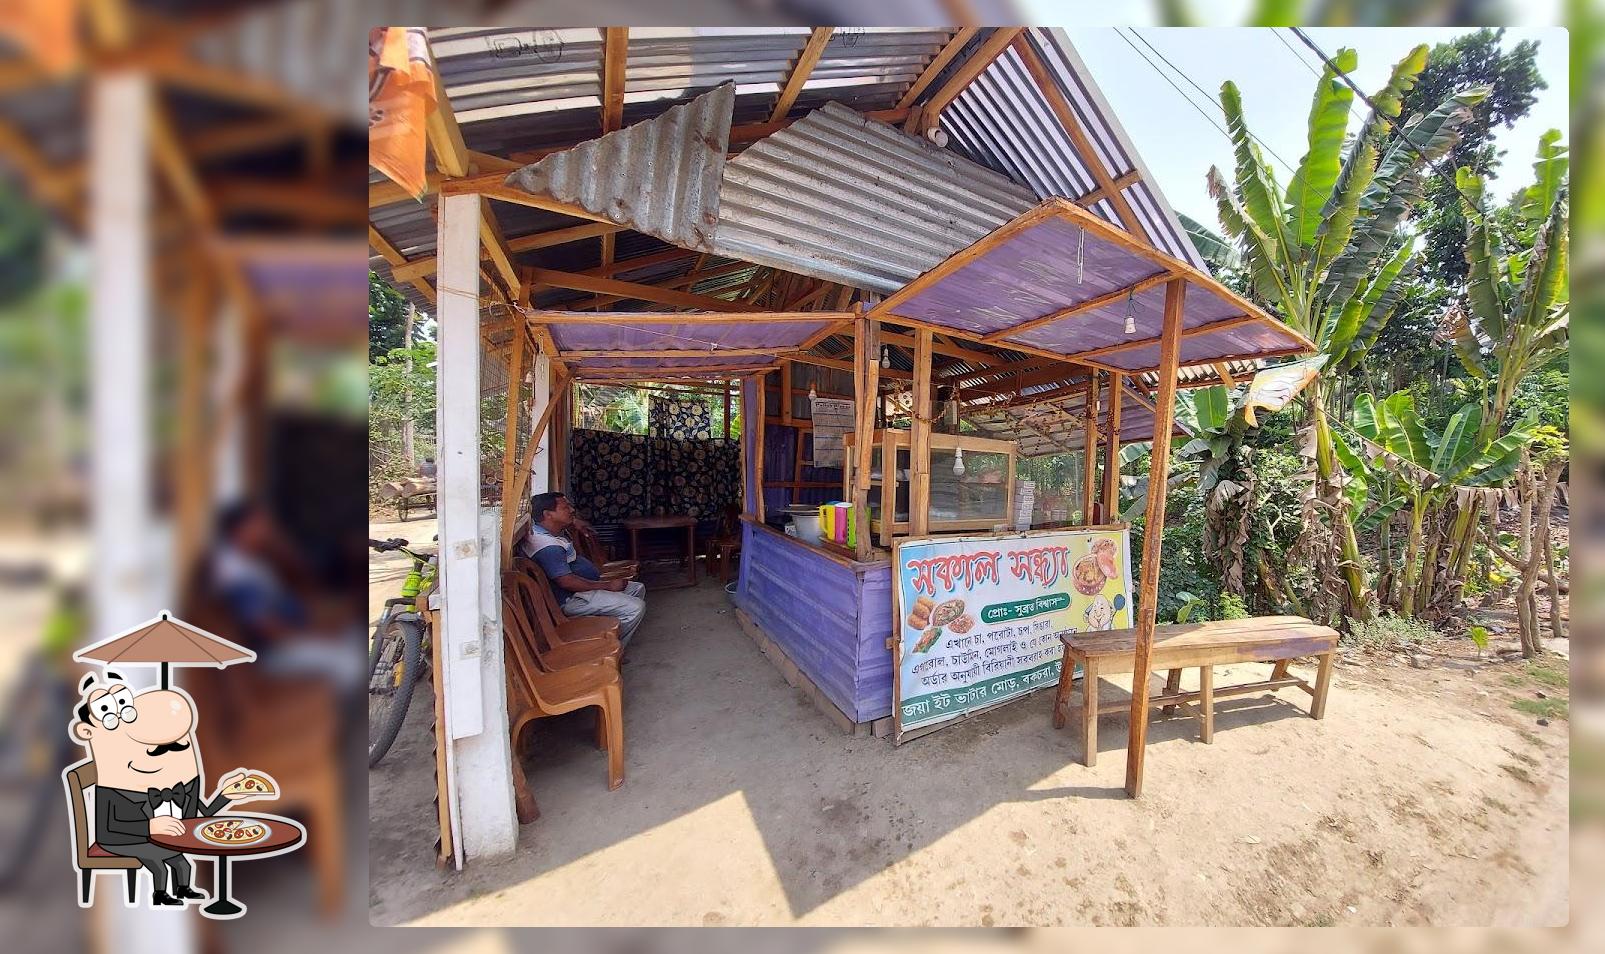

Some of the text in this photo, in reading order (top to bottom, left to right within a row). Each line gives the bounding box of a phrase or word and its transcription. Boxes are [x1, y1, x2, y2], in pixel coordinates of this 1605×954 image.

[907, 546, 1069, 596] সকাল সন্ধ্যা
[1014, 603, 1035, 616] সুব্রত
[946, 636, 972, 649] এখানে
[987, 627, 1016, 641] পরোটা,
[912, 656, 949, 674] এগরোল,
[950, 648, 982, 665] চাউমিন,
[985, 640, 1018, 658] মোগলাই
[1020, 641, 1027, 649] ও
[1029, 638, 1037, 649] যে
[921, 671, 947, 686] অর্ডার
[950, 662, 980, 683] অনুযায়ী
[934, 692, 950, 710] ইট
[955, 686, 987, 704] ভাটার
[992, 678, 1020, 695] মোড়,
